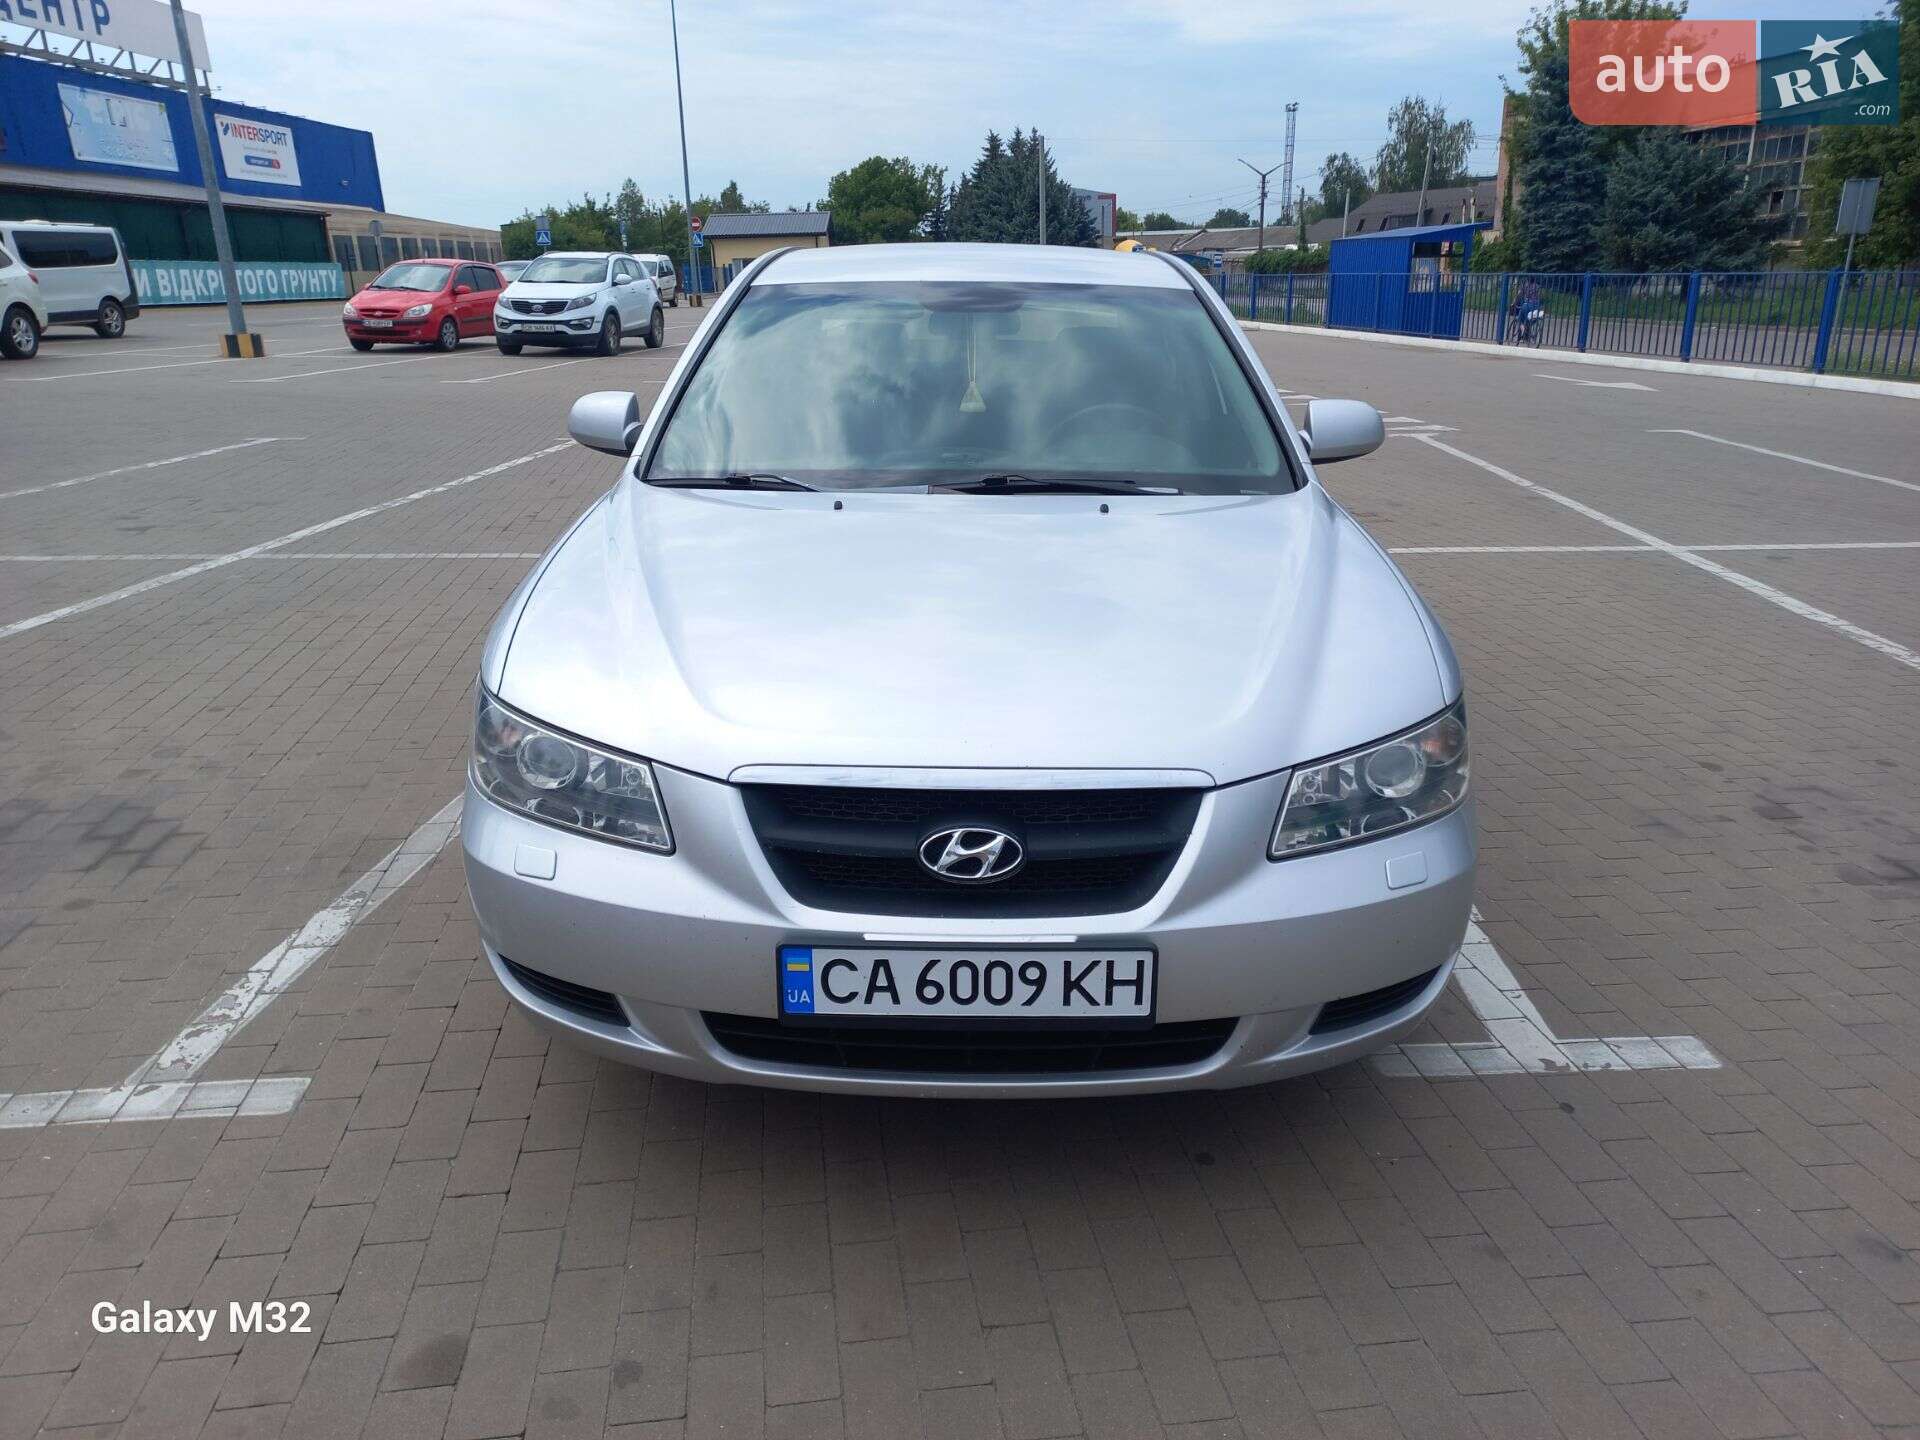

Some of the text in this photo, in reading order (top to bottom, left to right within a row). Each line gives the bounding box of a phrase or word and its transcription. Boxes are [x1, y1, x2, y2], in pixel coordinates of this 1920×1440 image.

[230, 122, 288, 147] INTERSPORT
[155, 268, 278, 302] ВІДКРТОГО
[787, 989, 811, 1003] UA
[820, 958, 1145, 1007] CA 6009 KH
